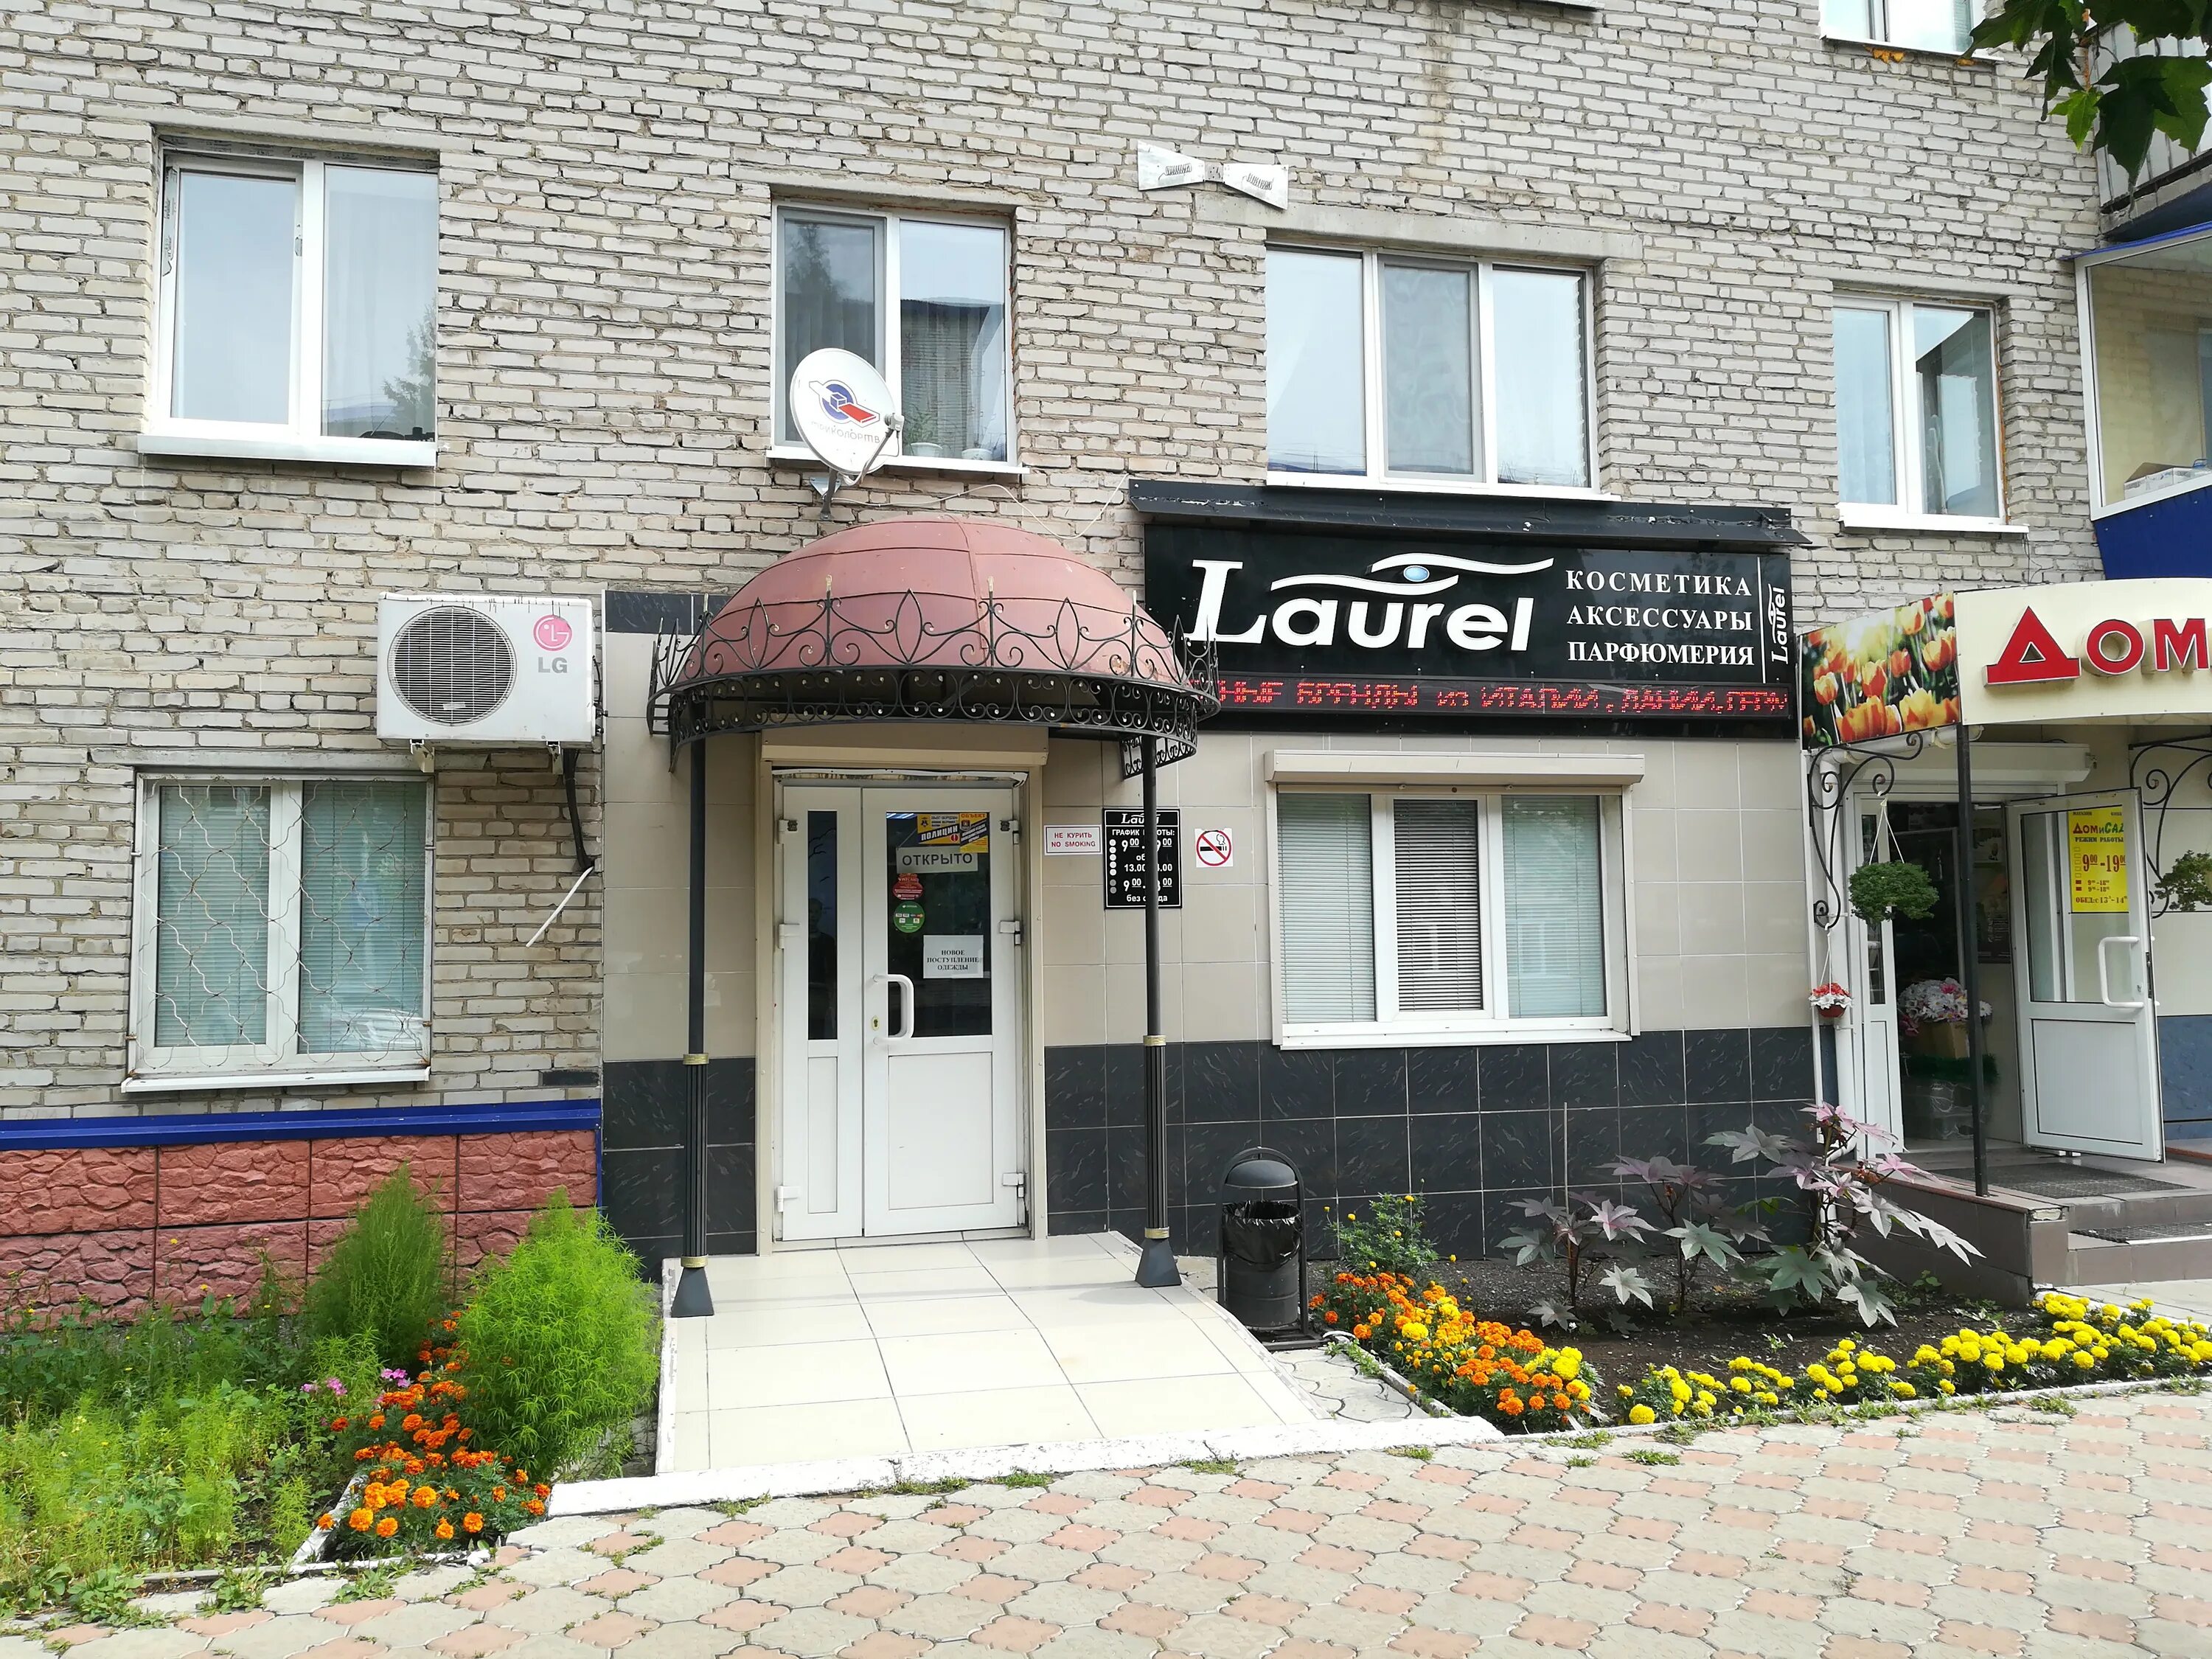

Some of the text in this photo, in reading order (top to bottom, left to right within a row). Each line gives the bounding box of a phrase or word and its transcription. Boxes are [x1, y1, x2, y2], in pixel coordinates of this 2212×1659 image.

[1565, 570, 1752, 596] КОСМЕТИКА
[1184, 559, 1534, 651] Laurel
[1566, 605, 1753, 630] АКСЕССУАРЫ
[1771, 587, 1788, 664] Laurel
[1567, 641, 1755, 666] ПАРФЮМЕРИЯ
[1983, 605, 2210, 685] ДОМ
[538, 657, 568, 673] LG
[921, 825, 958, 841] ПОЛИЦИИ
[902, 853, 973, 866] ОТКРЫТО
